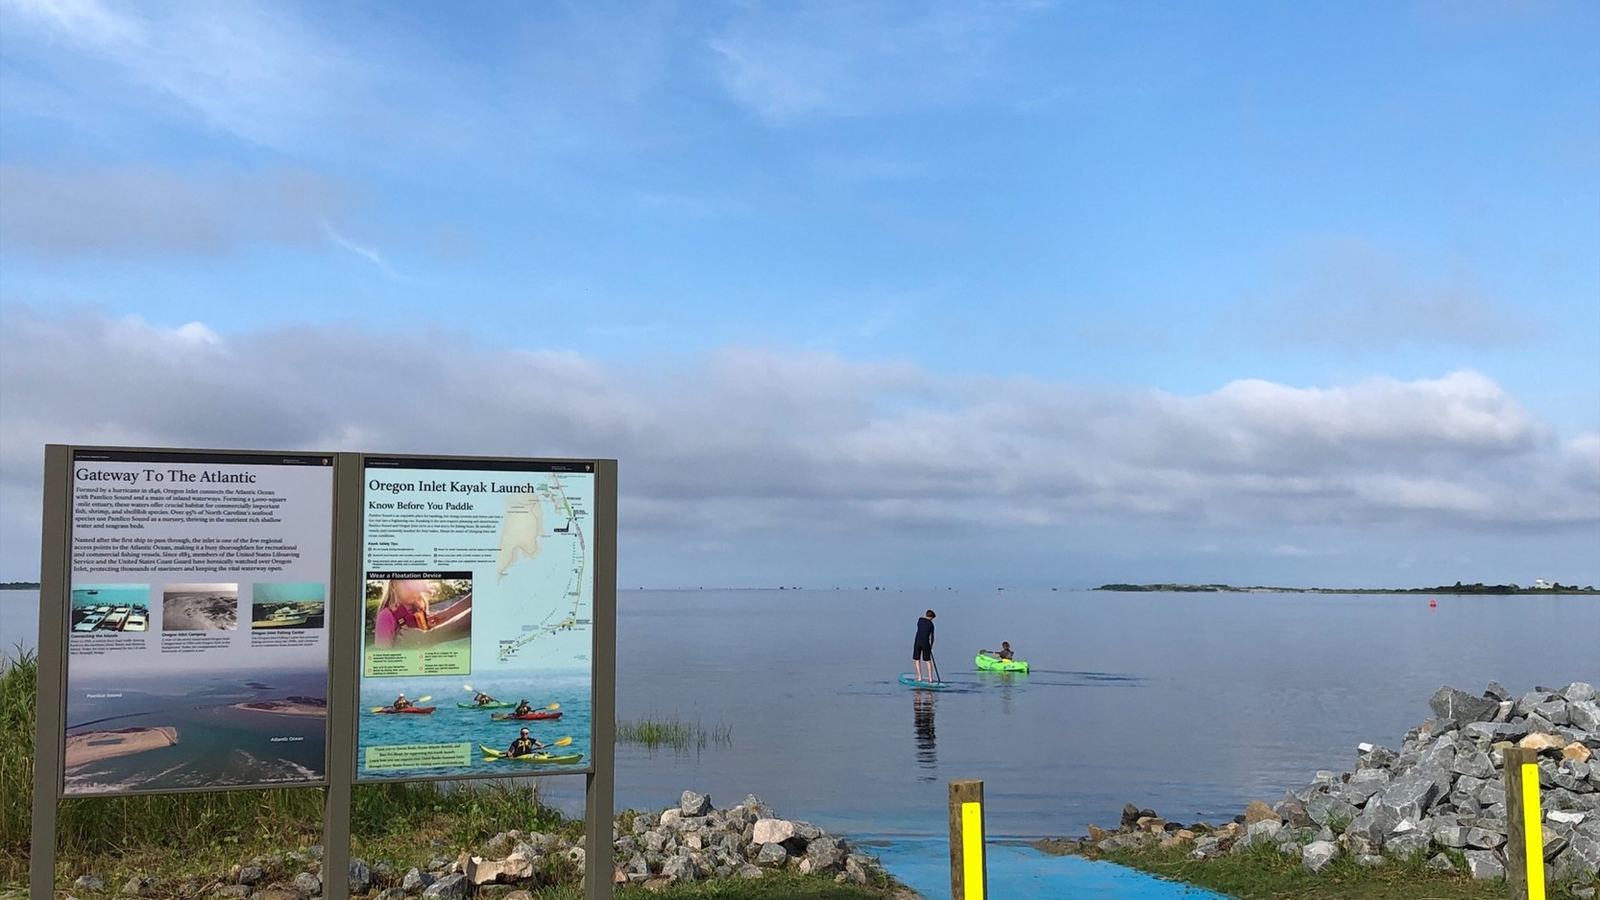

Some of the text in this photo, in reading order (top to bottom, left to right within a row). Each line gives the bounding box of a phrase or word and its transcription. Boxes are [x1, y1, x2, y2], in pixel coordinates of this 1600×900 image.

[76, 468, 256, 484] Gateway To The Atlantic
[369, 480, 414, 494] Oregon
[418, 481, 446, 492] Inlet
[450, 481, 487, 495] Kayak
[491, 482, 534, 494] Launch
[368, 501, 474, 511] Know Before You Paddle
